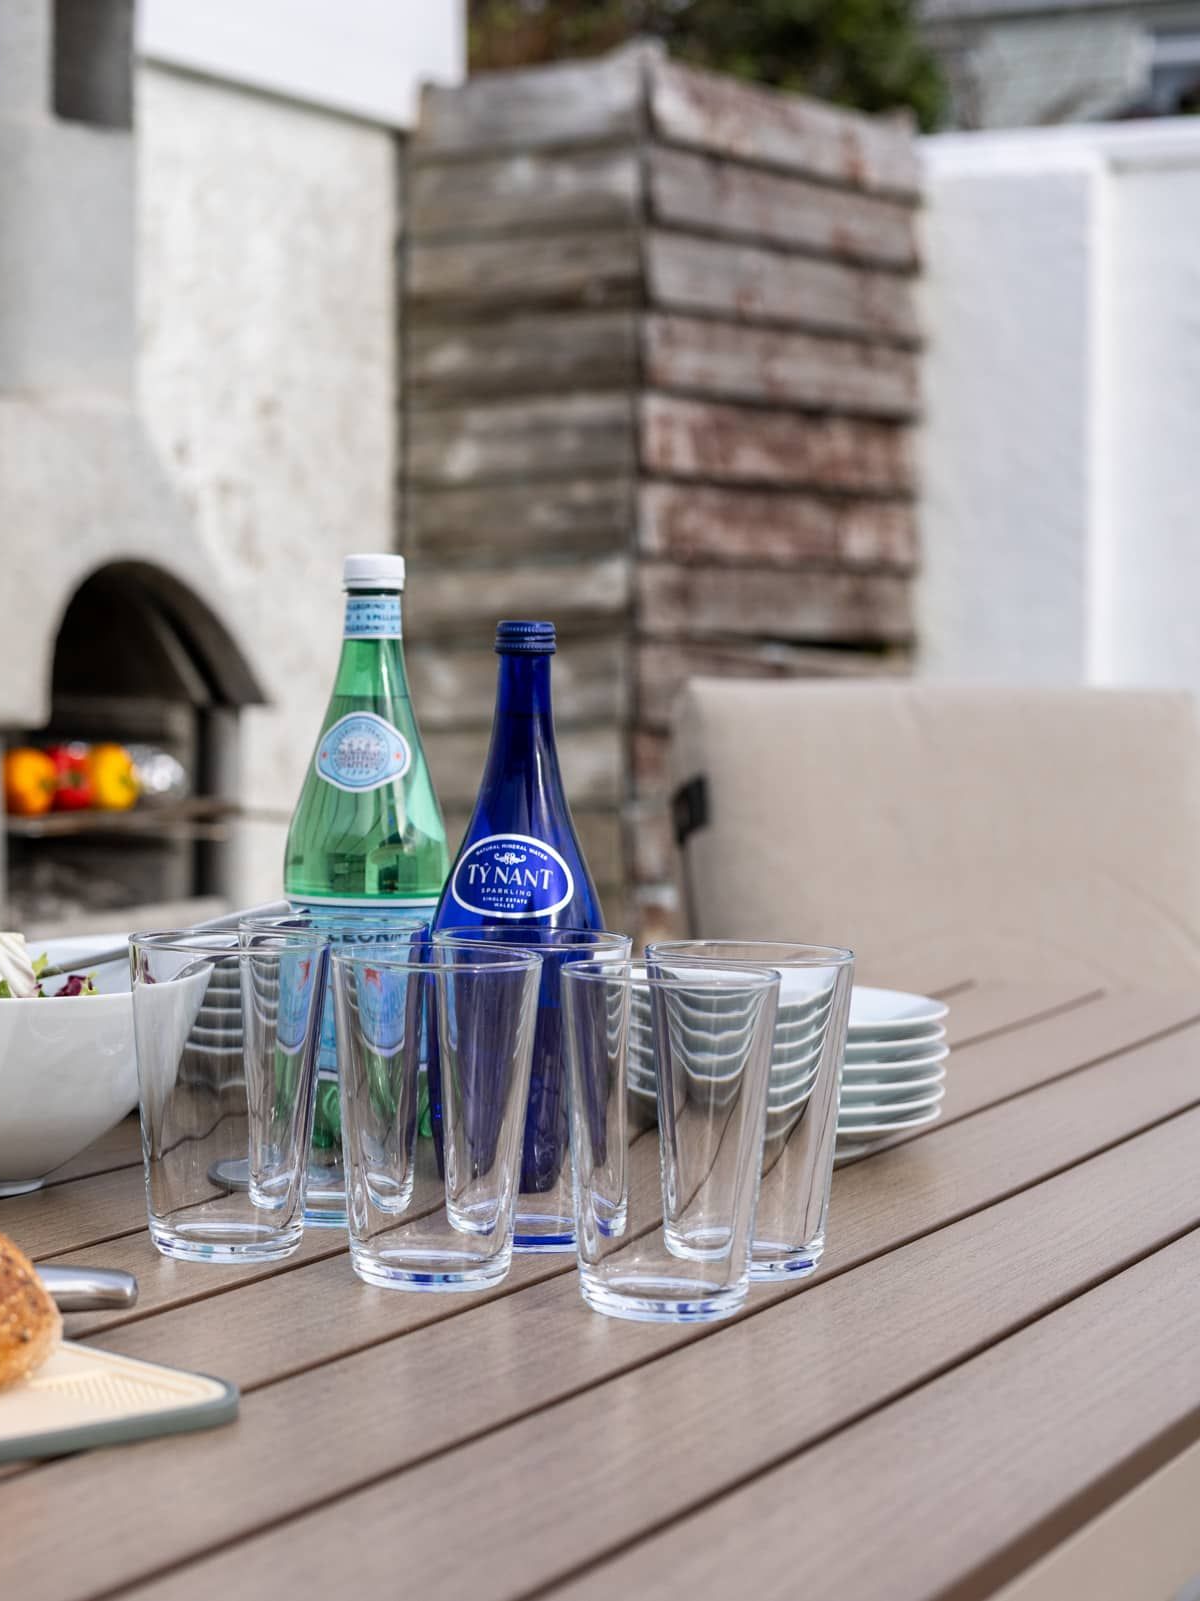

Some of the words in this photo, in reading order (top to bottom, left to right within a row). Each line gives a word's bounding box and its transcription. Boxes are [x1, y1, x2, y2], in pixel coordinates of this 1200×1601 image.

[475, 844, 500, 856] NATURAL
[501, 843, 528, 852] MINERAL
[528, 847, 549, 861] WATER
[494, 866, 554, 890] NANT
[481, 887, 532, 897] SPARKLING
[505, 896, 529, 905] ESTATE
